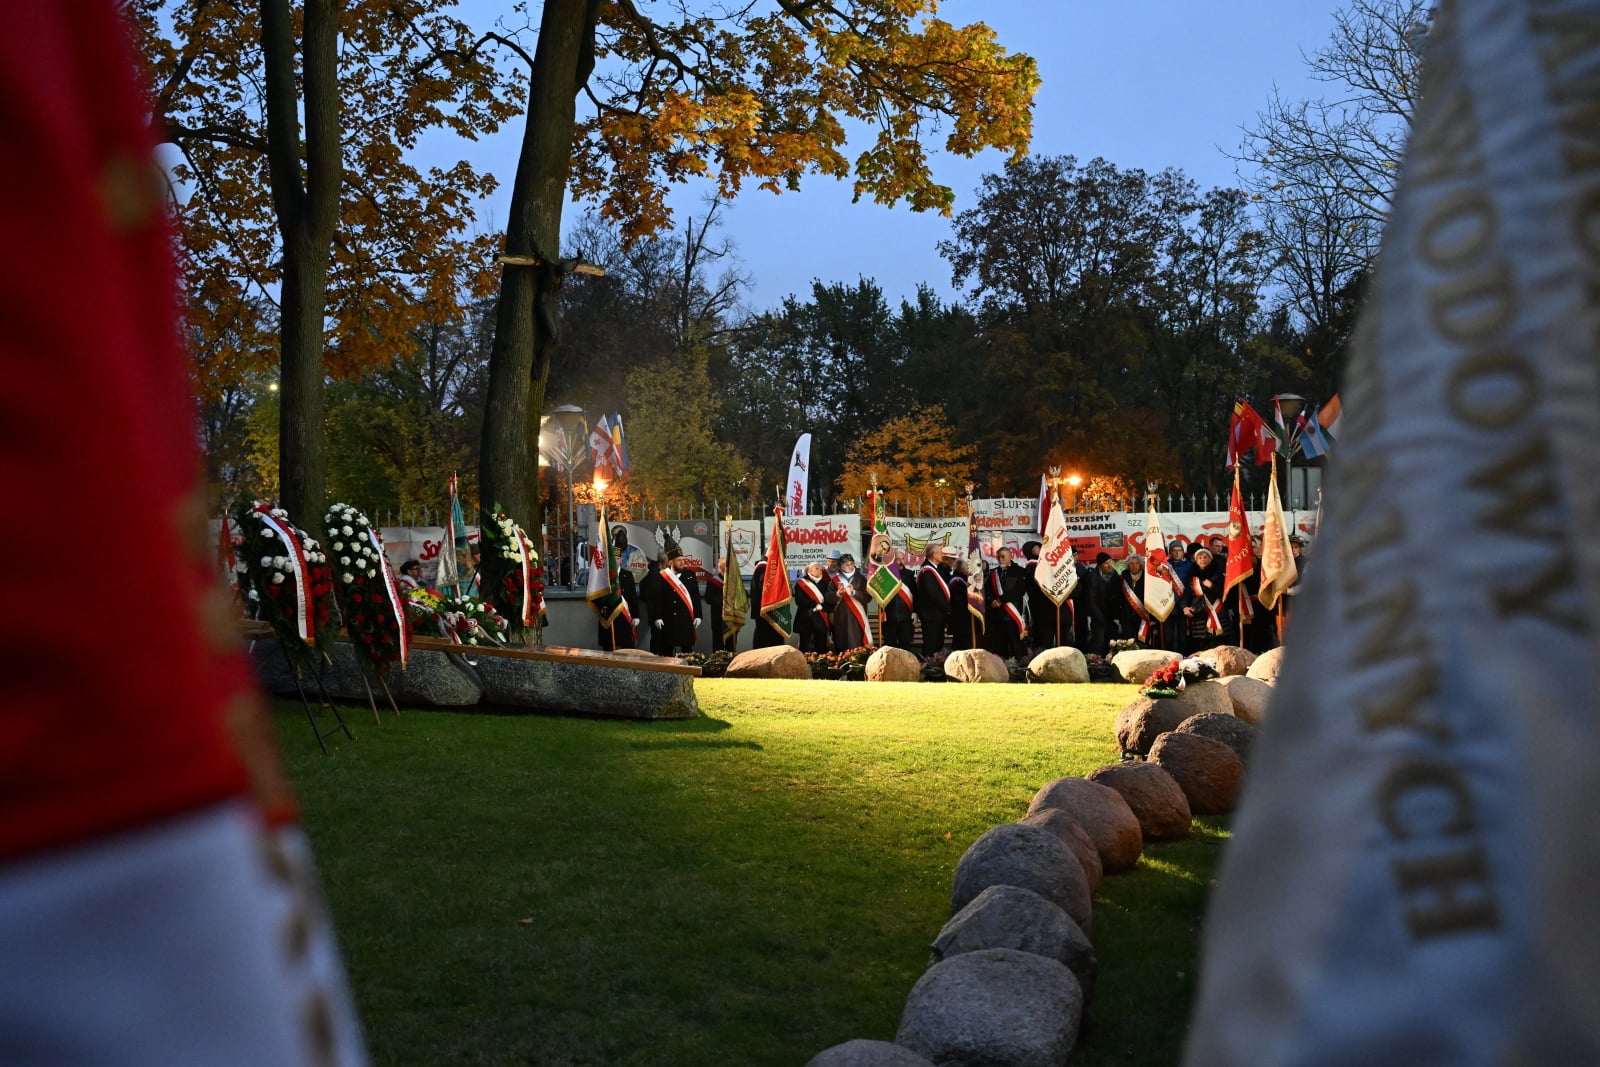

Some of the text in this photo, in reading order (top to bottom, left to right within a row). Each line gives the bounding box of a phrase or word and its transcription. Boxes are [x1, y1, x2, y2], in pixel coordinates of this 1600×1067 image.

[886, 521, 912, 529] REGION
[1067, 523, 1116, 531] POLAKAMI
[1127, 519, 1142, 527] SZZ
